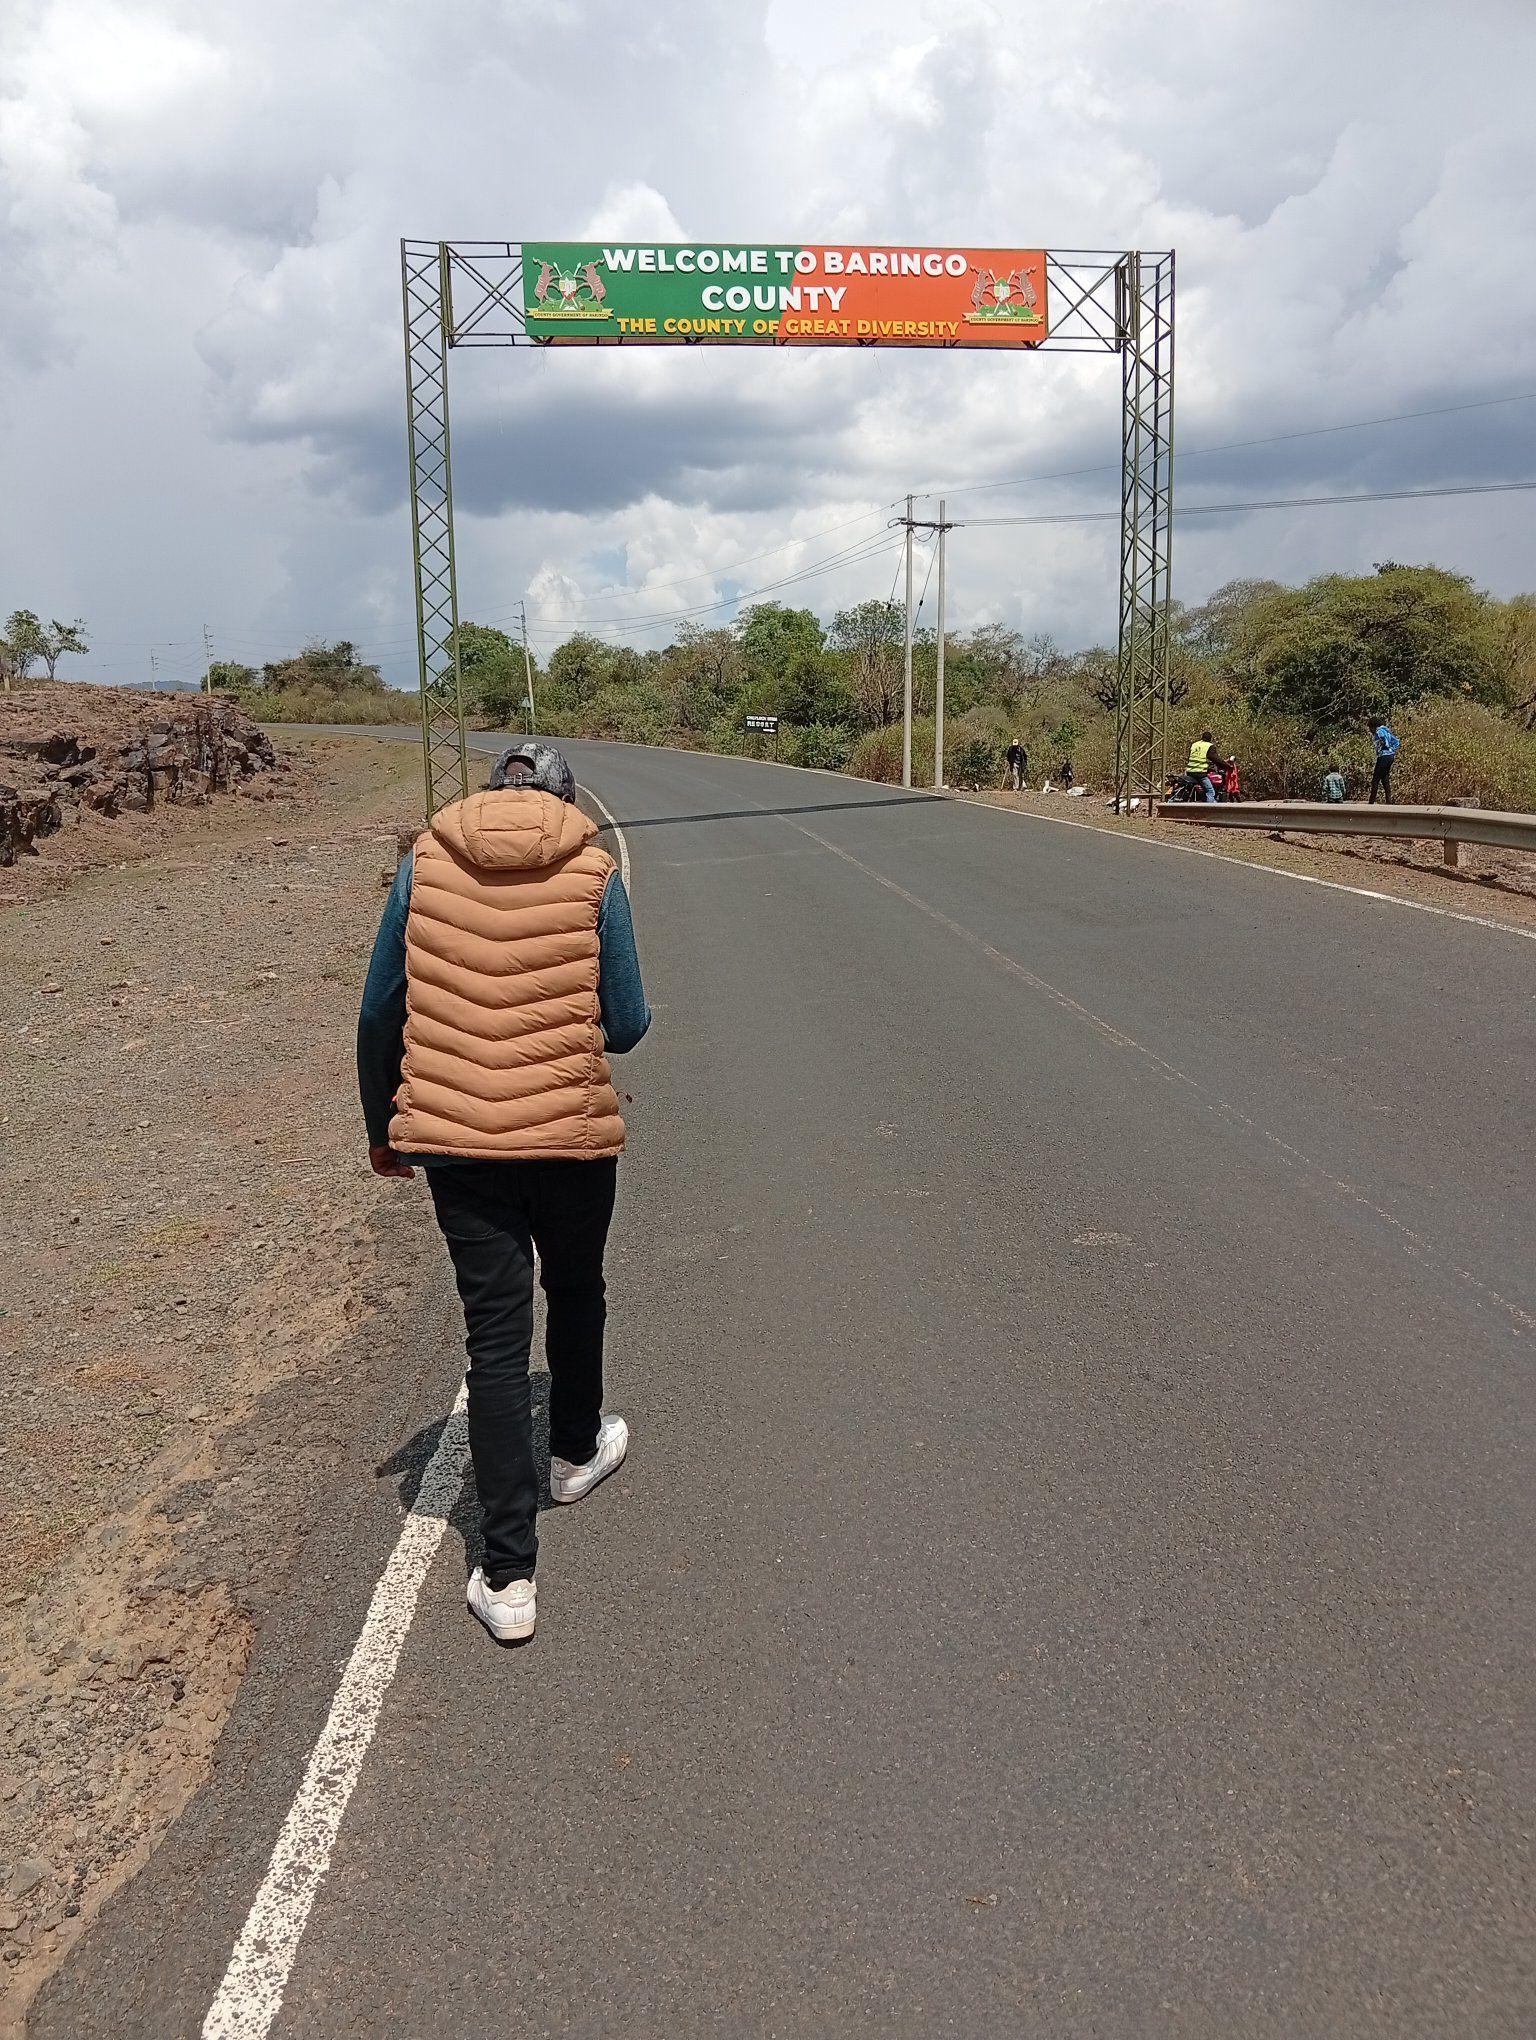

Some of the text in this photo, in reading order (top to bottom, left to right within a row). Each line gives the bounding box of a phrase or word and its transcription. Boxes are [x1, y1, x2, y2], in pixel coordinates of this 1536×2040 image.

[602, 248, 967, 276] WELCOME TO BARINGO
[701, 285, 847, 312] COUNTY
[617, 317, 959, 336] THE COUNTY OF GREAT DIVERSITY
